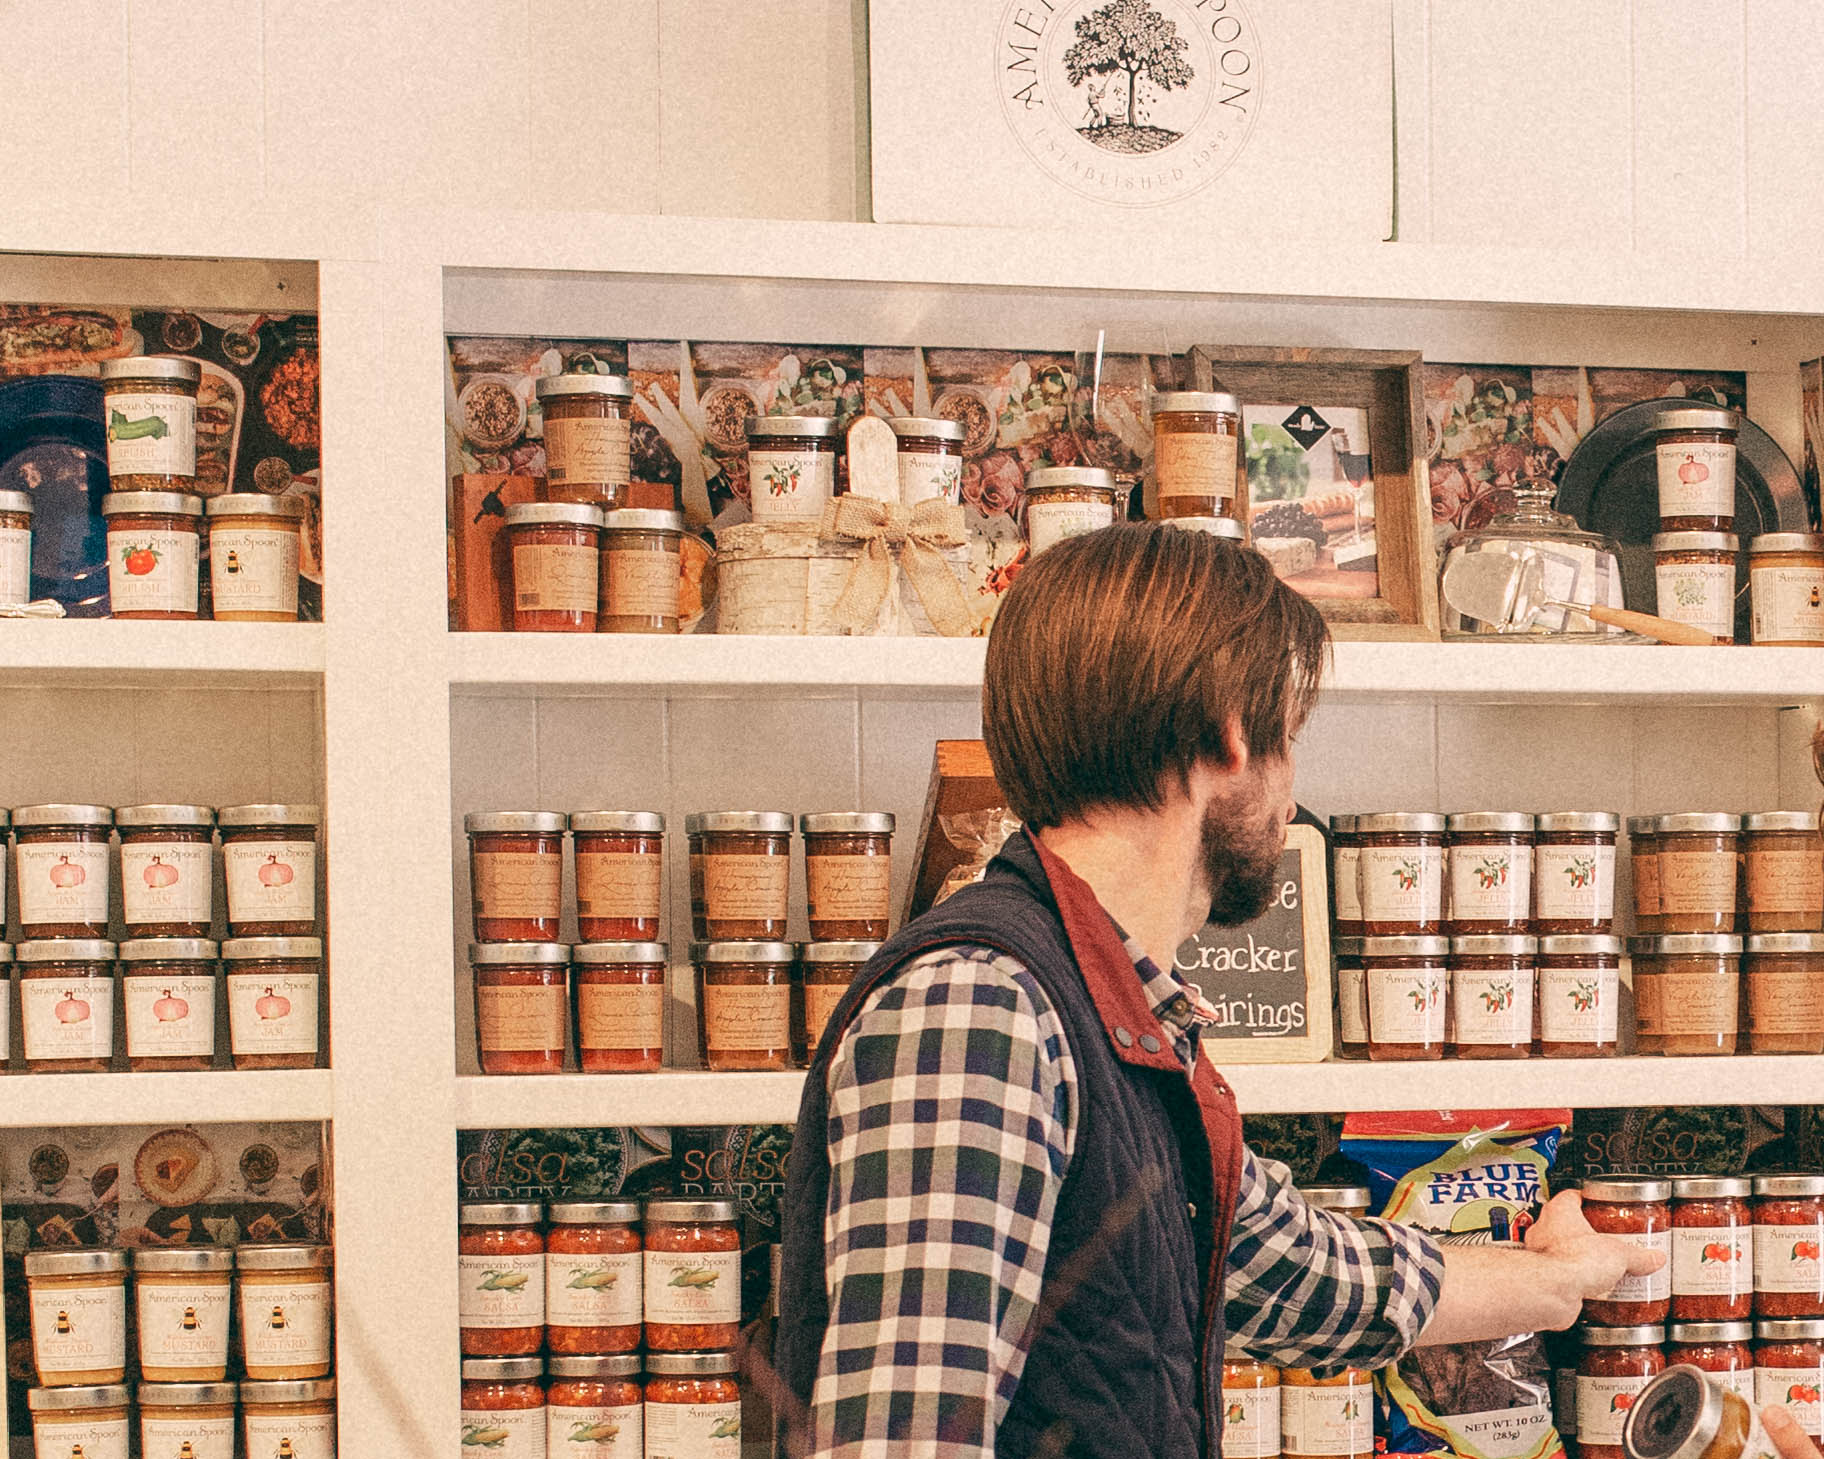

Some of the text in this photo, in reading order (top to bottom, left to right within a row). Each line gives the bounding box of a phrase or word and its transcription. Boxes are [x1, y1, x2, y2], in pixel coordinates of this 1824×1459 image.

[56, 895, 79, 905] JAM
[151, 895, 171, 904] JAM
[264, 895, 287, 904] JAM
[1174, 934, 1299, 972] Cracker
[1188, 983, 1304, 1034] irings
[62, 1031, 84, 1040] JAM
[160, 1030, 182, 1039] JAM
[261, 1028, 283, 1036] JAM
[460, 1130, 571, 1185] alsa
[1429, 1163, 1540, 1184] BLUE
[1426, 1181, 1542, 1205] FARM
[599, 1256, 629, 1271] Spoon
[651, 1255, 730, 1268] American Spoon
[75, 1295, 106, 1307] Spoon
[150, 1293, 202, 1303] American
[290, 1291, 319, 1304] Spoon
[673, 1299, 709, 1308] SALSA
[483, 1303, 519, 1313] SALSA
[574, 1301, 609, 1311] SALSA
[162, 1339, 217, 1349] MUSTARD
[255, 1338, 307, 1348] MUSTARD
[1590, 1381, 1637, 1392] American
[490, 1413, 523, 1429] Spoon
[551, 1409, 630, 1425] American Spoon
[297, 1422, 326, 1436] Spoon
[1464, 1422, 1488, 1434] NET
[1515, 1417, 1528, 1427] 10
[89, 1427, 119, 1443] Spoon
[1492, 1429, 1521, 1441] (283g)
